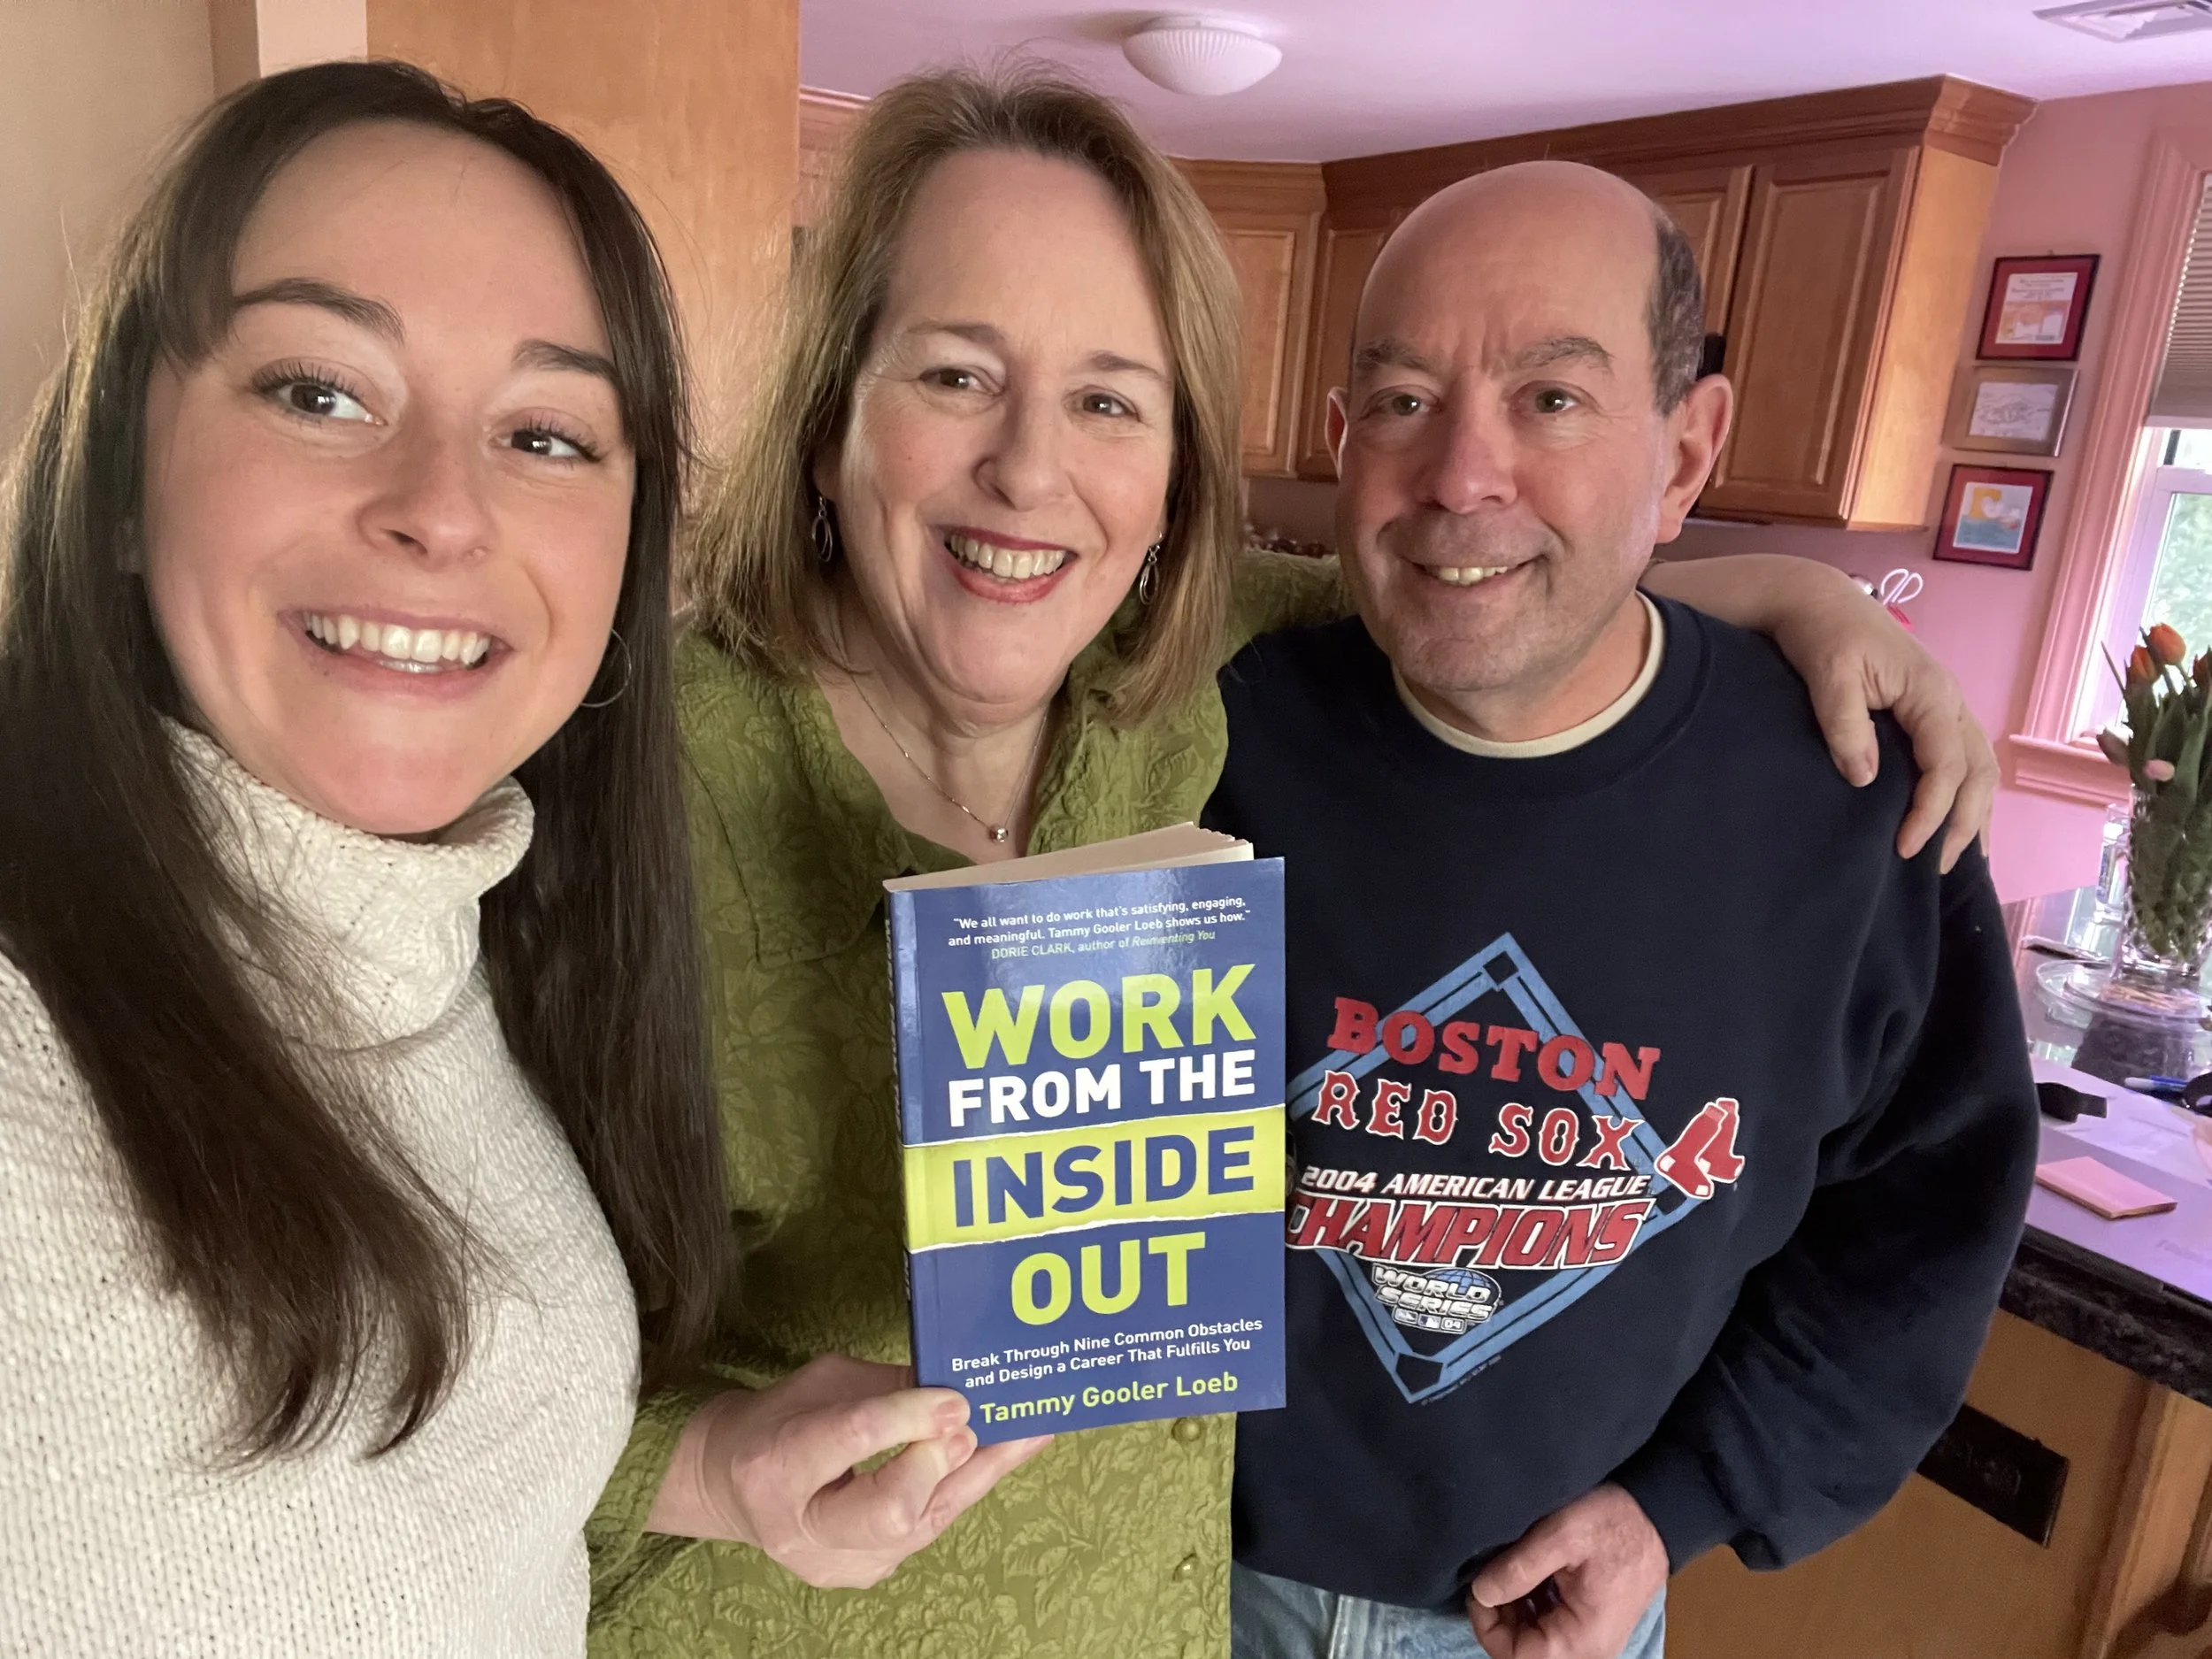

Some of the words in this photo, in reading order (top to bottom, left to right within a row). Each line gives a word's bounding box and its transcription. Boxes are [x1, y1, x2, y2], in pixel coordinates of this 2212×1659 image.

[948, 934, 971, 947] and
[974, 929, 1046, 945] meaningful.
[1048, 926, 1090, 939] Tammy
[1093, 922, 1131, 933] Gooler
[1134, 919, 1164, 931] Loeb
[1165, 916, 1201, 927] shows
[1203, 914, 1217, 924] us
[981, 917, 997, 928] all
[999, 915, 1028, 926] want
[1032, 913, 1043, 925] to
[1047, 911, 1061, 923] do
[1064, 909, 1093, 922] work
[1131, 901, 1189, 917] satisfying,
[1192, 896, 1246, 910] engaging,
[991, 946, 1028, 960] DORIE
[1031, 942, 1075, 956] CLARK,
[1078, 939, 1115, 952] author
[1118, 936, 1130, 948] of
[1132, 932, 1194, 948] Reinventing
[1196, 930, 1216, 941] You
[941, 964, 1256, 1070] WORK
[1326, 996, 1661, 1100] BOSTON
[948, 1064, 1122, 1127] FROM
[1139, 1048, 1256, 1104] THE
[1311, 1070, 1458, 1145] RED
[1488, 1102, 1646, 1171] SOX
[953, 1125, 1255, 1228] INSIDE
[1302, 1165, 1379, 1194] 2004
[1380, 1173, 1536, 1202] AMERICAN
[1538, 1175, 1652, 1202] LEAGUE
[1010, 1231, 1206, 1325] OUT
[1374, 1265, 1492, 1302] WORLD
[1377, 1285, 1494, 1320] SERIES
[952, 1353, 1000, 1371] Break
[1003, 1341, 1070, 1363] Through
[1073, 1337, 1110, 1352] Nine
[1114, 1328, 1184, 1345] Common
[1188, 1318, 1263, 1337] Obstacles
[965, 1371, 995, 1388] and
[999, 1364, 1053, 1382] Design
[1056, 1363, 1066, 1372] a
[1070, 1353, 1124, 1370] Career
[1127, 1347, 1163, 1363] That
[1166, 1340, 1220, 1358] Fulfills
[1223, 1338, 1250, 1352] You
[979, 1394, 1076, 1424] Tammy
[1082, 1381, 1169, 1408] Gooler
[1176, 1371, 1238, 1396] Loeb
